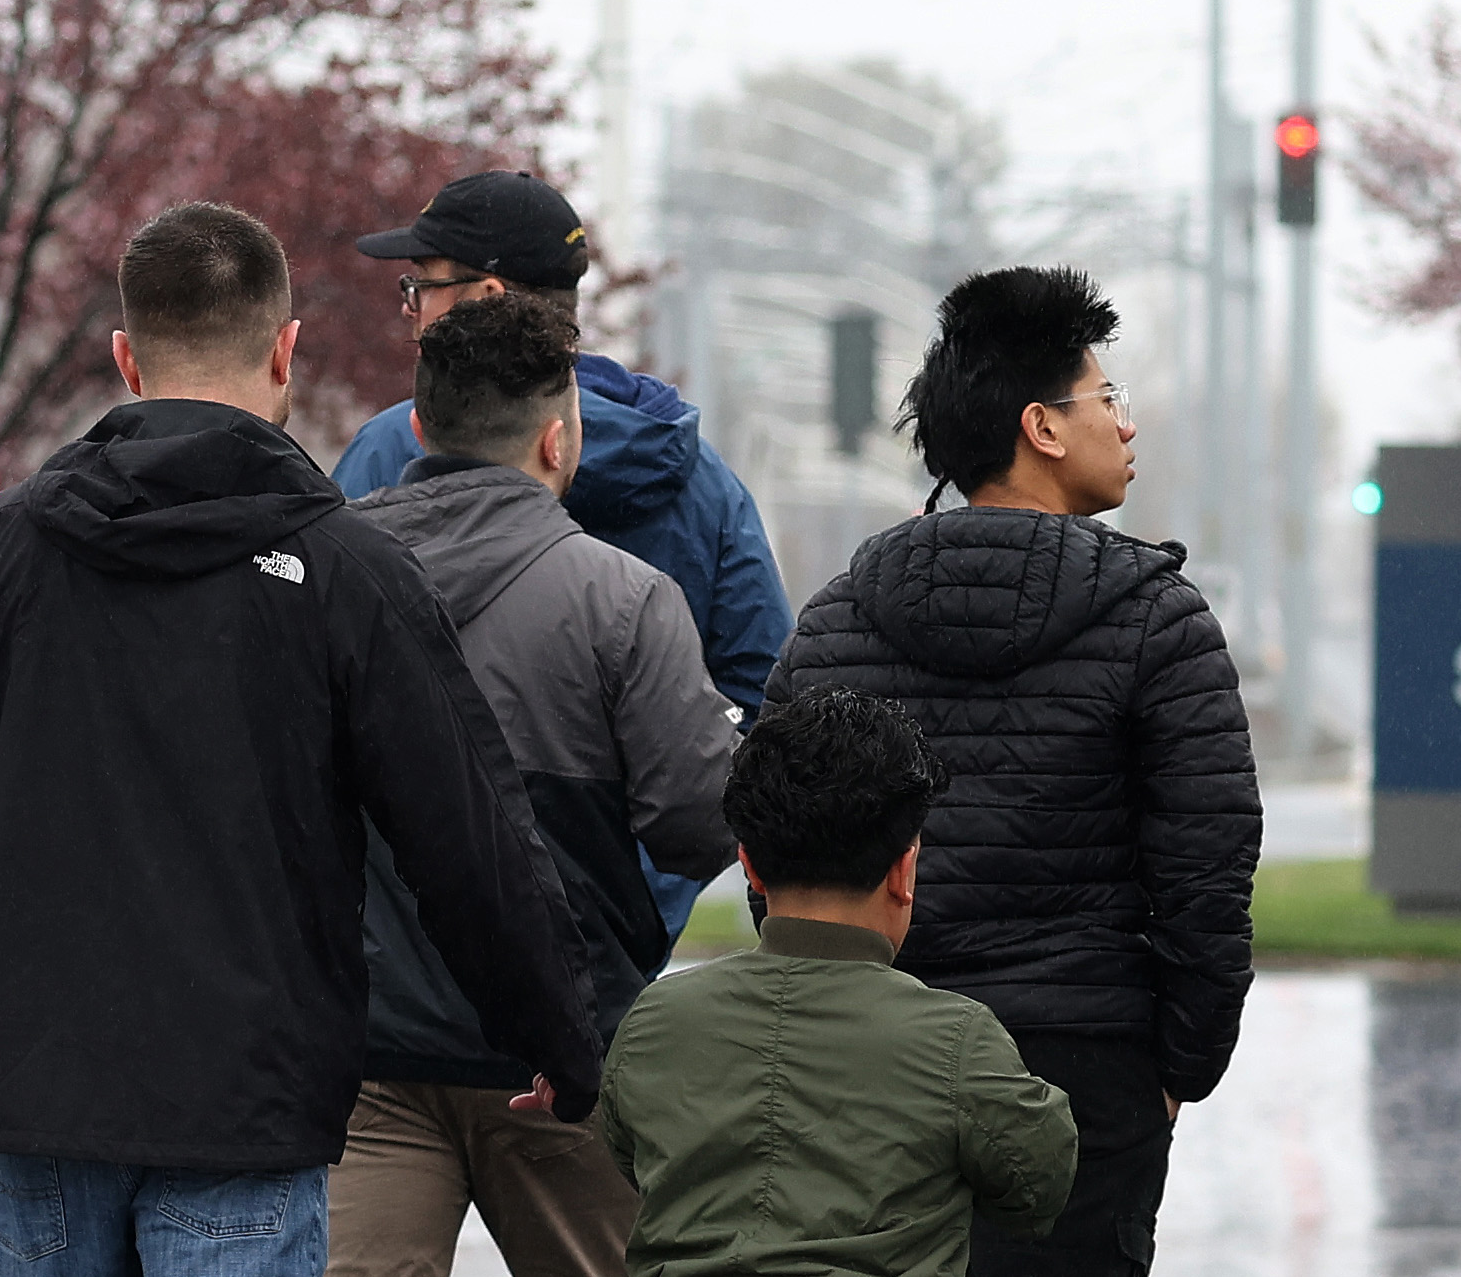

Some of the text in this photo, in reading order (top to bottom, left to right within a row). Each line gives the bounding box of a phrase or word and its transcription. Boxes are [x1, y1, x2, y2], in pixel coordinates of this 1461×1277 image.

[252, 555, 289, 570] NORTH
[271, 551, 290, 563] THE
[260, 564, 289, 579] FACE
